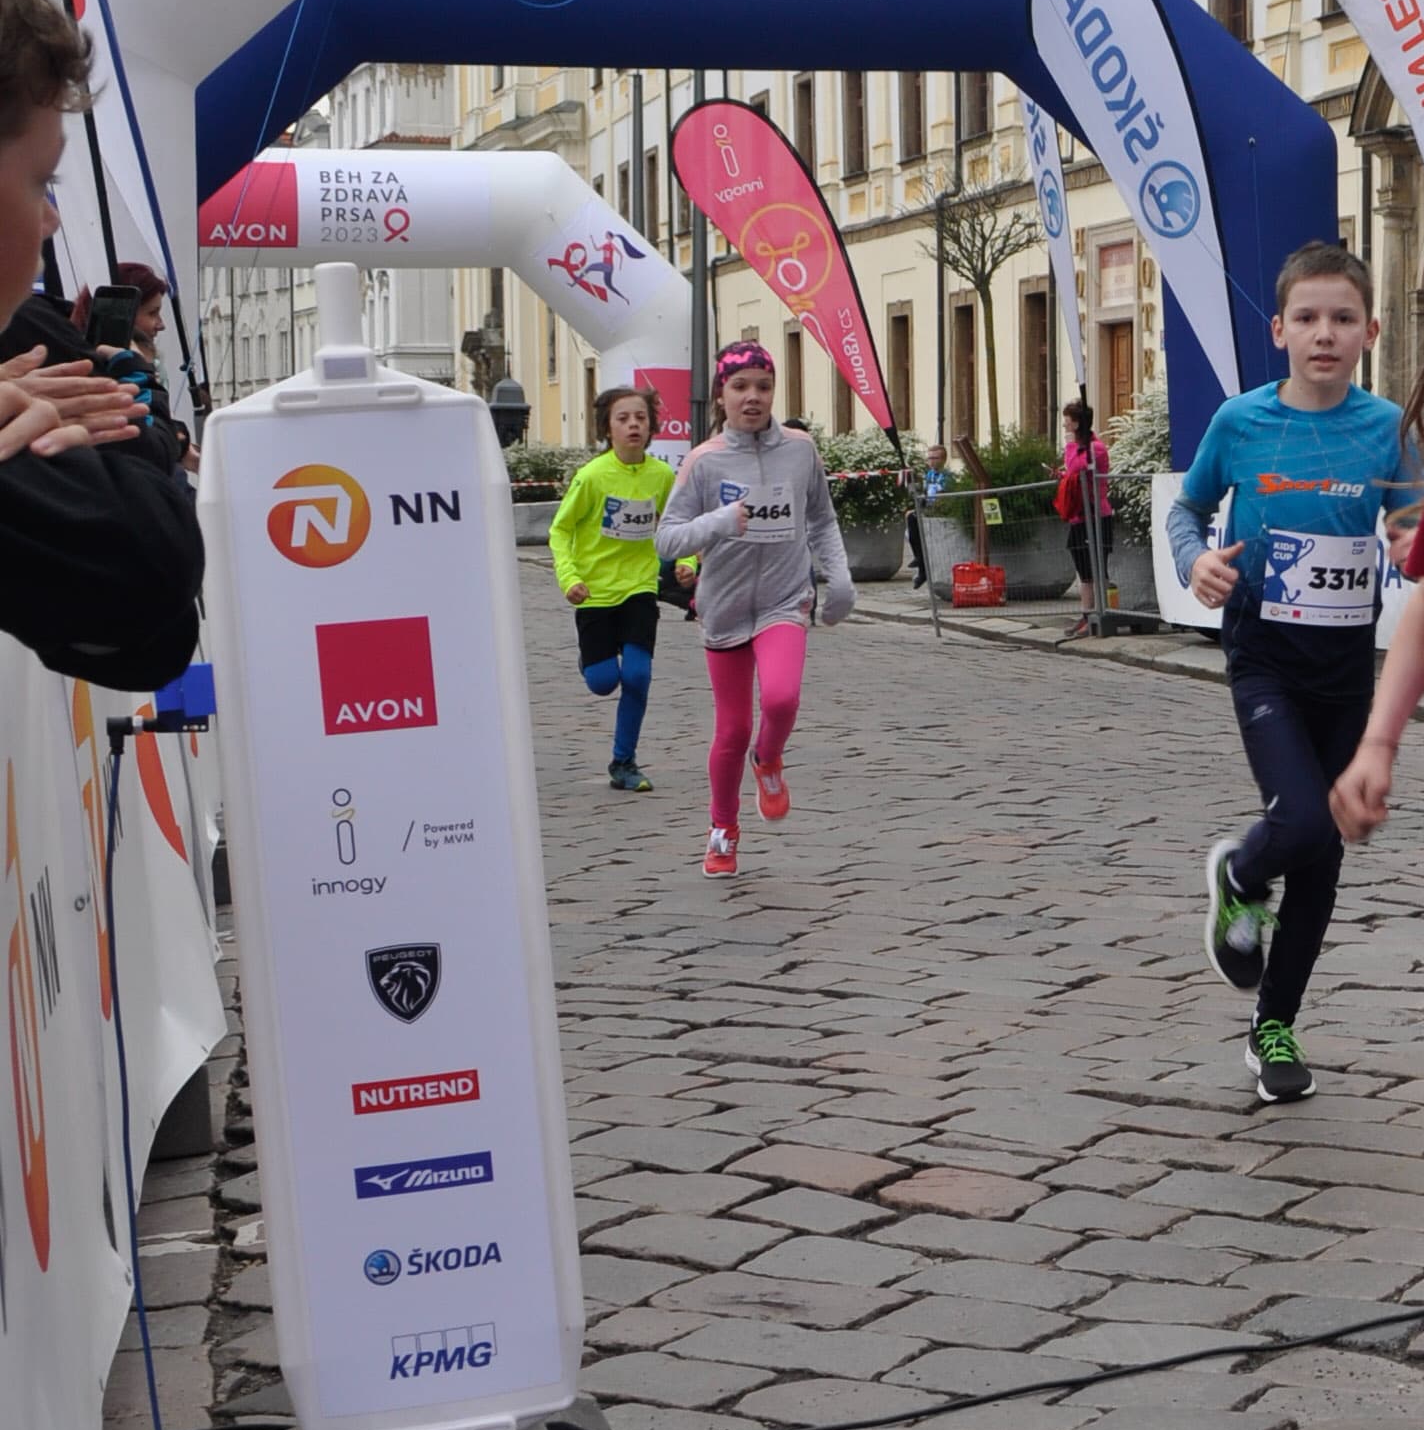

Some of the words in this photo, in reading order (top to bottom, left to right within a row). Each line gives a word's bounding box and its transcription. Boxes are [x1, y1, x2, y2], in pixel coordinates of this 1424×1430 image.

[371, 171, 399, 183] ZA
[320, 185, 408, 203] ZDRAVÁ
[321, 207, 375, 222] PRSA
[209, 223, 287, 241] AVON
[321, 227, 378, 243] 2023
[390, 491, 462, 525] NN
[746, 504, 791, 520] 3464
[1273, 542, 1296, 552] KIDS
[1273, 552, 1293, 561] CUP
[1309, 567, 1369, 590] 3314
[336, 697, 424, 725] AVON
[423, 819, 474, 833] Powered
[424, 837, 439, 849] by
[444, 833, 474, 844] MVM
[312, 876, 387, 896] innogy
[373, 949, 433, 963] PEUGEOT
[360, 1077, 475, 1108] NUTREND
[407, 1242, 502, 1276] ŠKODA
[390, 1341, 494, 1379] KPMG
